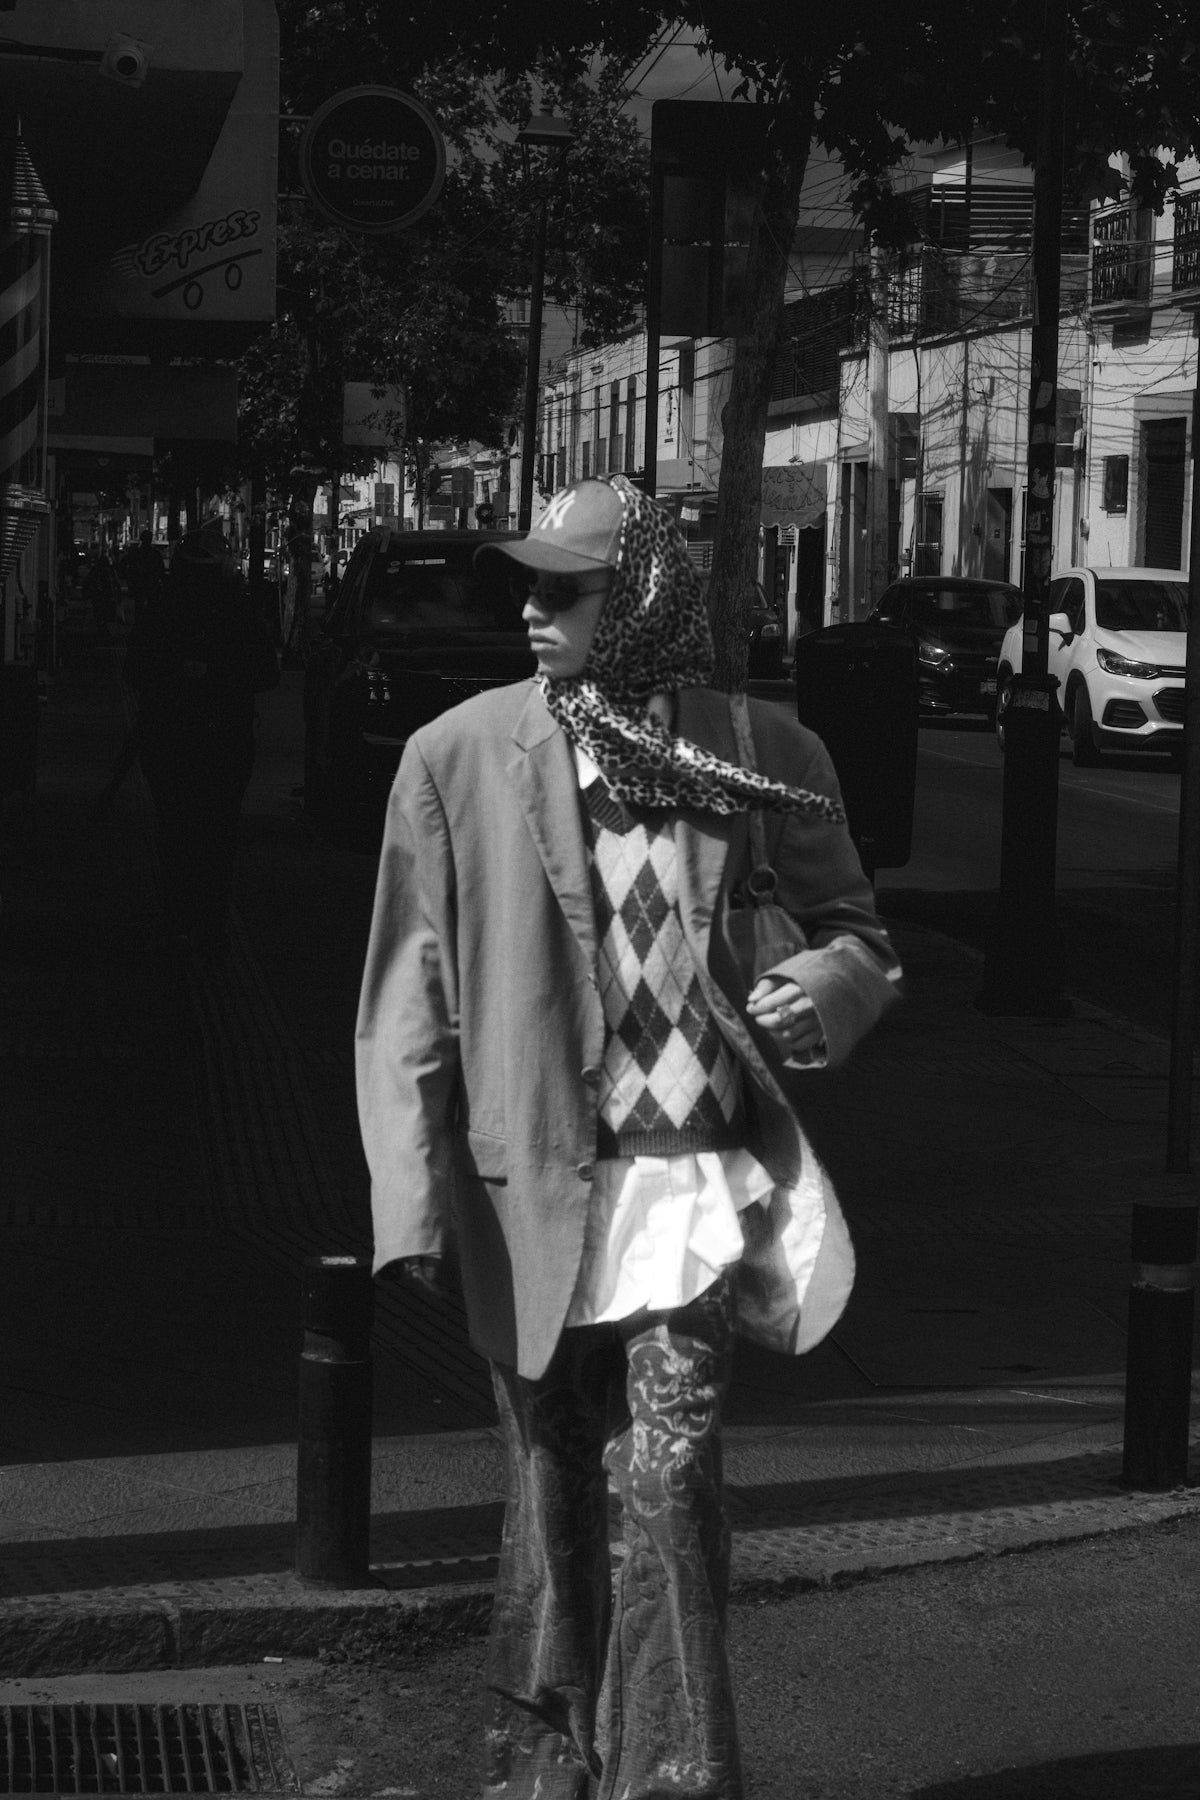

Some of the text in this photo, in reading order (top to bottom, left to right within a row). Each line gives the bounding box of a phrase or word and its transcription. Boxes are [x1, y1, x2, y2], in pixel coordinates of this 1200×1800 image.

[327, 138, 420, 161] Quédate
[327, 163, 411, 180] a cenar.
[138, 210, 260, 275] Express
